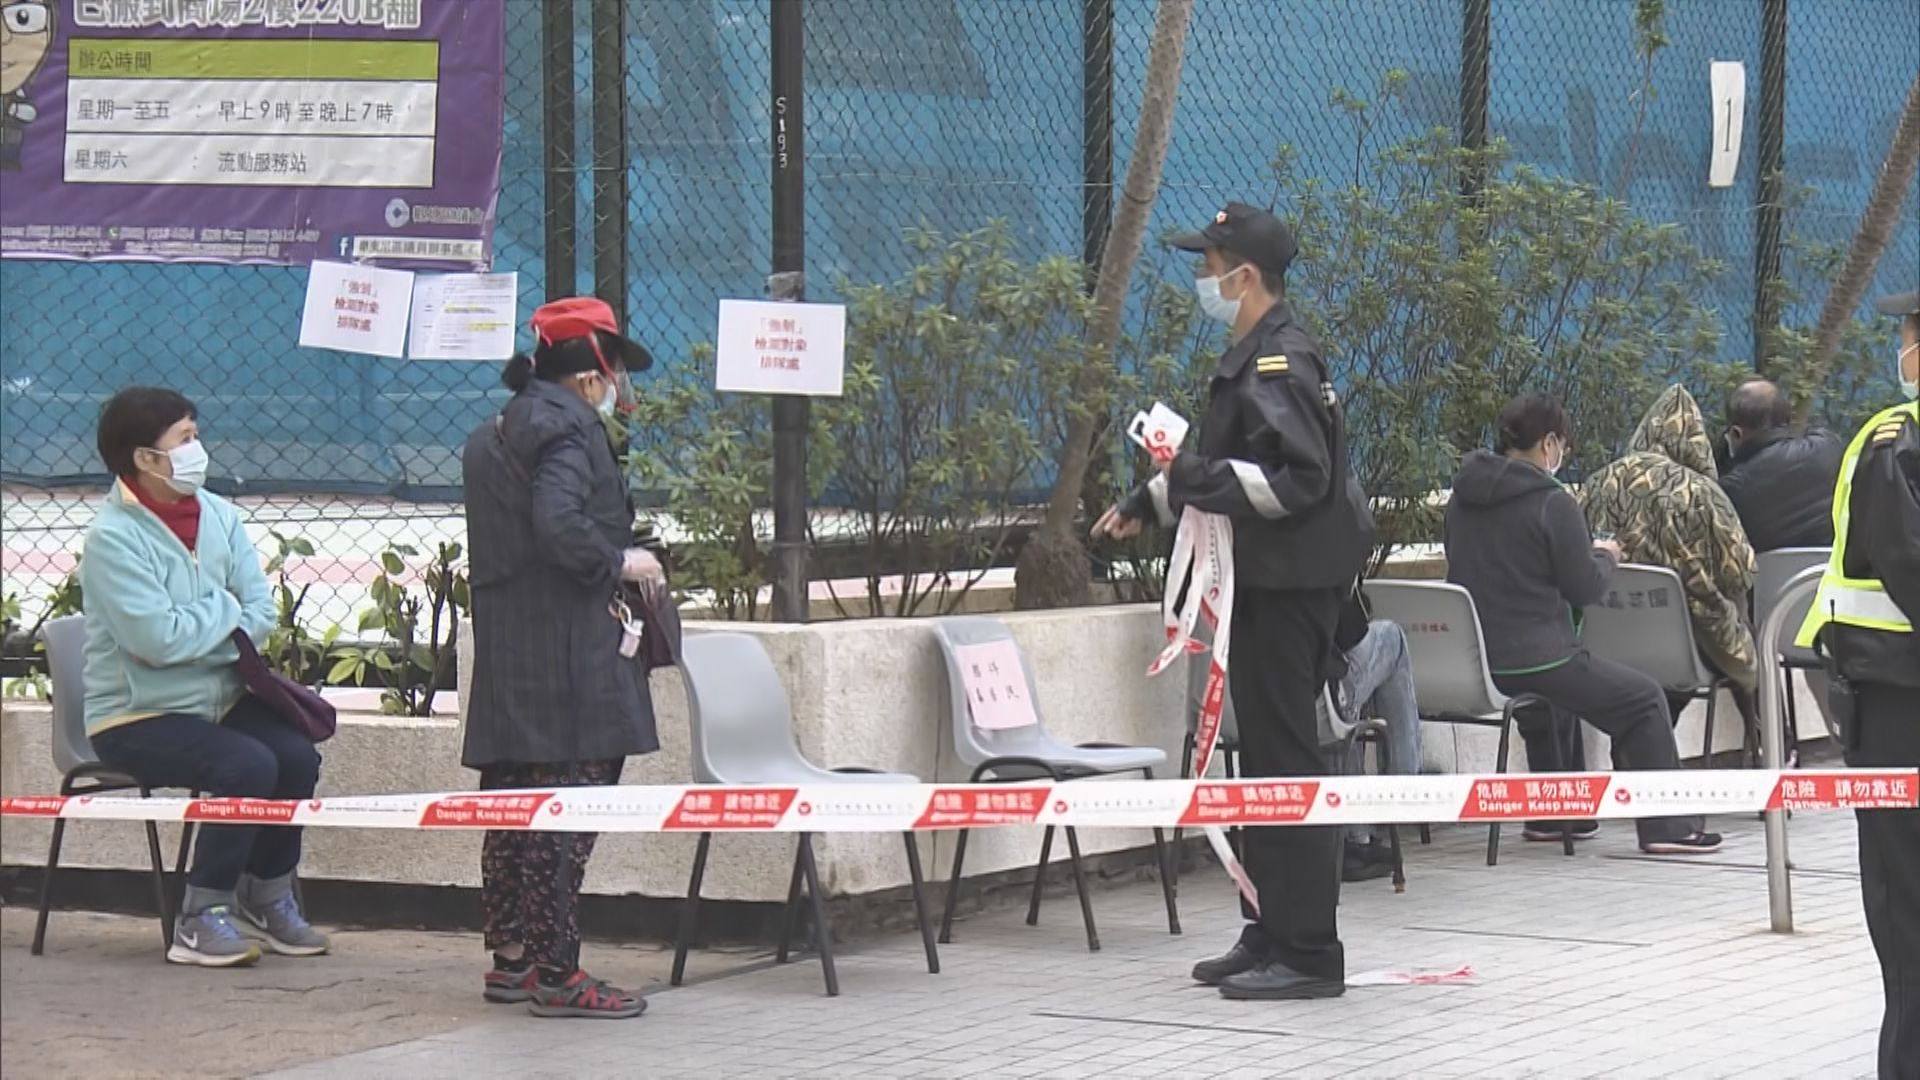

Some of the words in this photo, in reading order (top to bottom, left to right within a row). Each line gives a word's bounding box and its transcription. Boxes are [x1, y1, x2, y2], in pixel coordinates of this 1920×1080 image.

[79, 50, 151, 72] 辦公時間
[77, 99, 169, 120] 星期一至五
[74, 149, 128, 170] 星期六
[218, 152, 307, 173] 流動服務站
[1477, 781, 1508, 798] 危險
[1525, 780, 1591, 798] 請勿靠近
[1782, 779, 1816, 798] 危險
[1834, 779, 1908, 798] 請勿靠近
[200, 803, 235, 816] Danger
[239, 804, 265, 816] Keep
[436, 809, 473, 822] Danger
[1478, 801, 1522, 813] Danger
[1528, 800, 1561, 813] Keep
[1563, 801, 1594, 812] away
